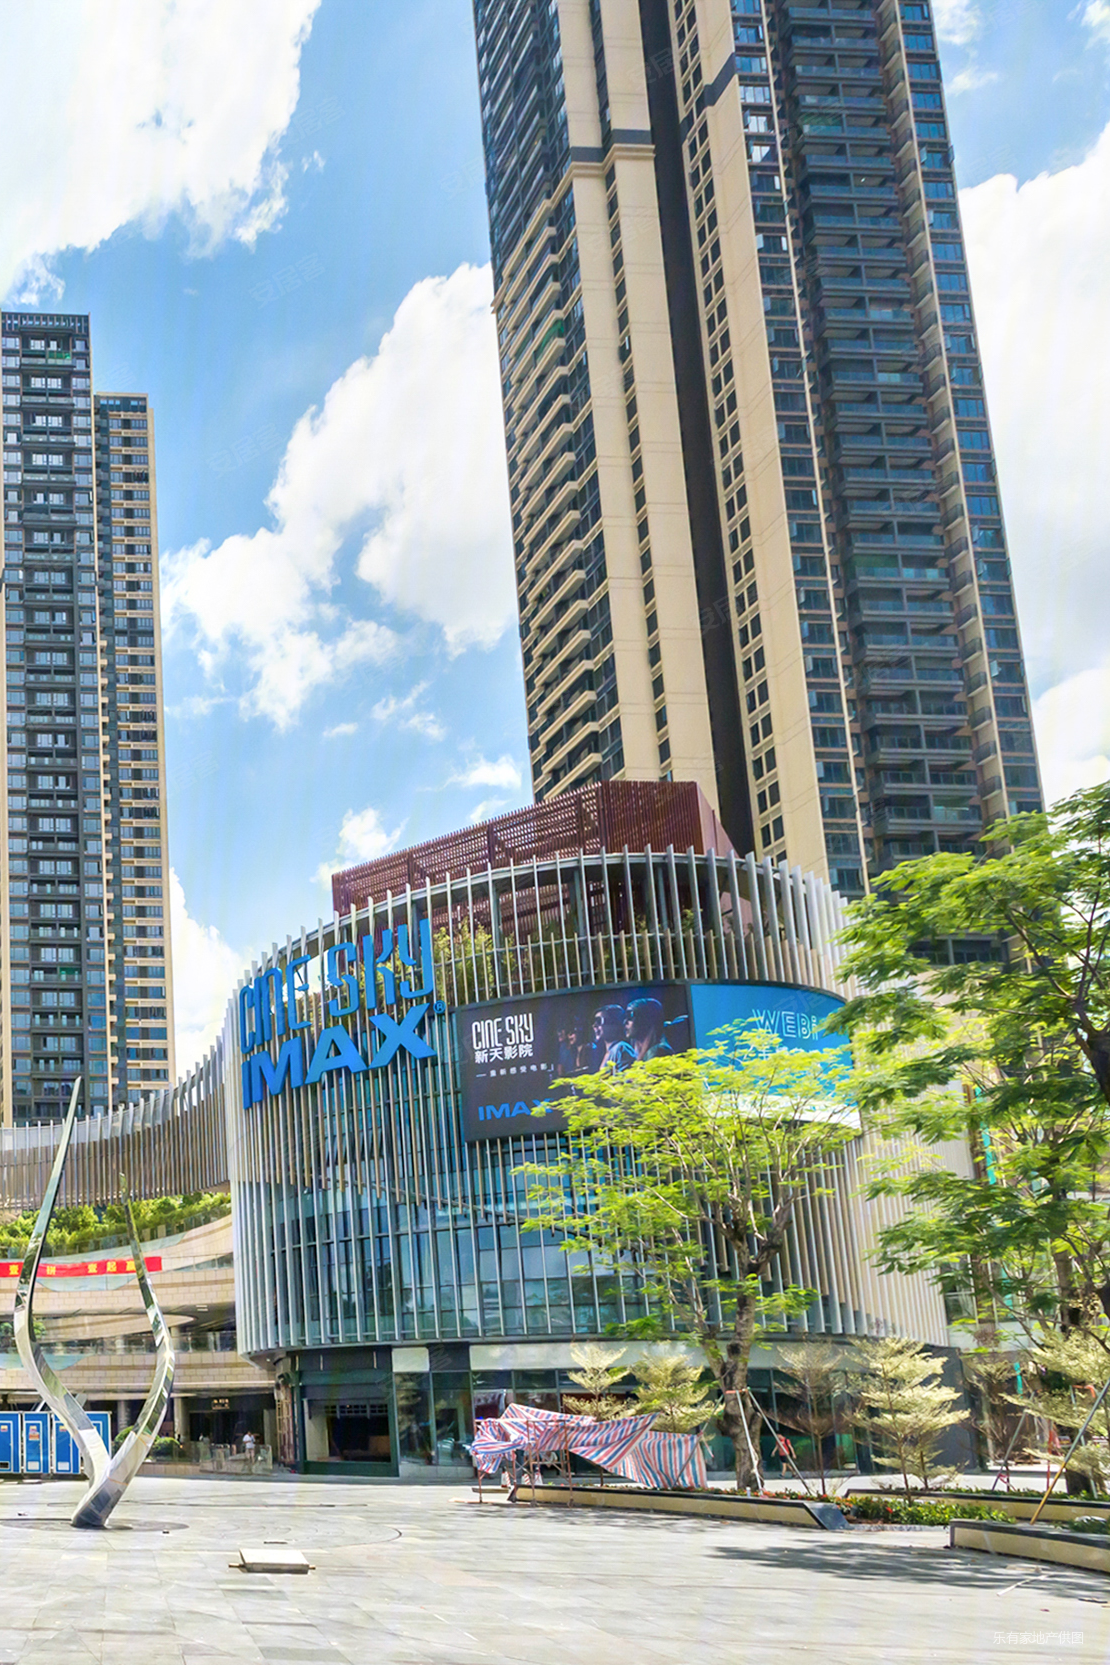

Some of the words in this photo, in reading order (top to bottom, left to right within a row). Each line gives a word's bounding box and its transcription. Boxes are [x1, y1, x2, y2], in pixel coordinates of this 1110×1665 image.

[240, 954, 312, 1054] CINE
[326, 918, 434, 1017] SKY
[241, 1002, 438, 1110] IMAX
[472, 1017, 504, 1050] CINE
[505, 1012, 535, 1046] SKY
[474, 1044, 534, 1064] 新天影院
